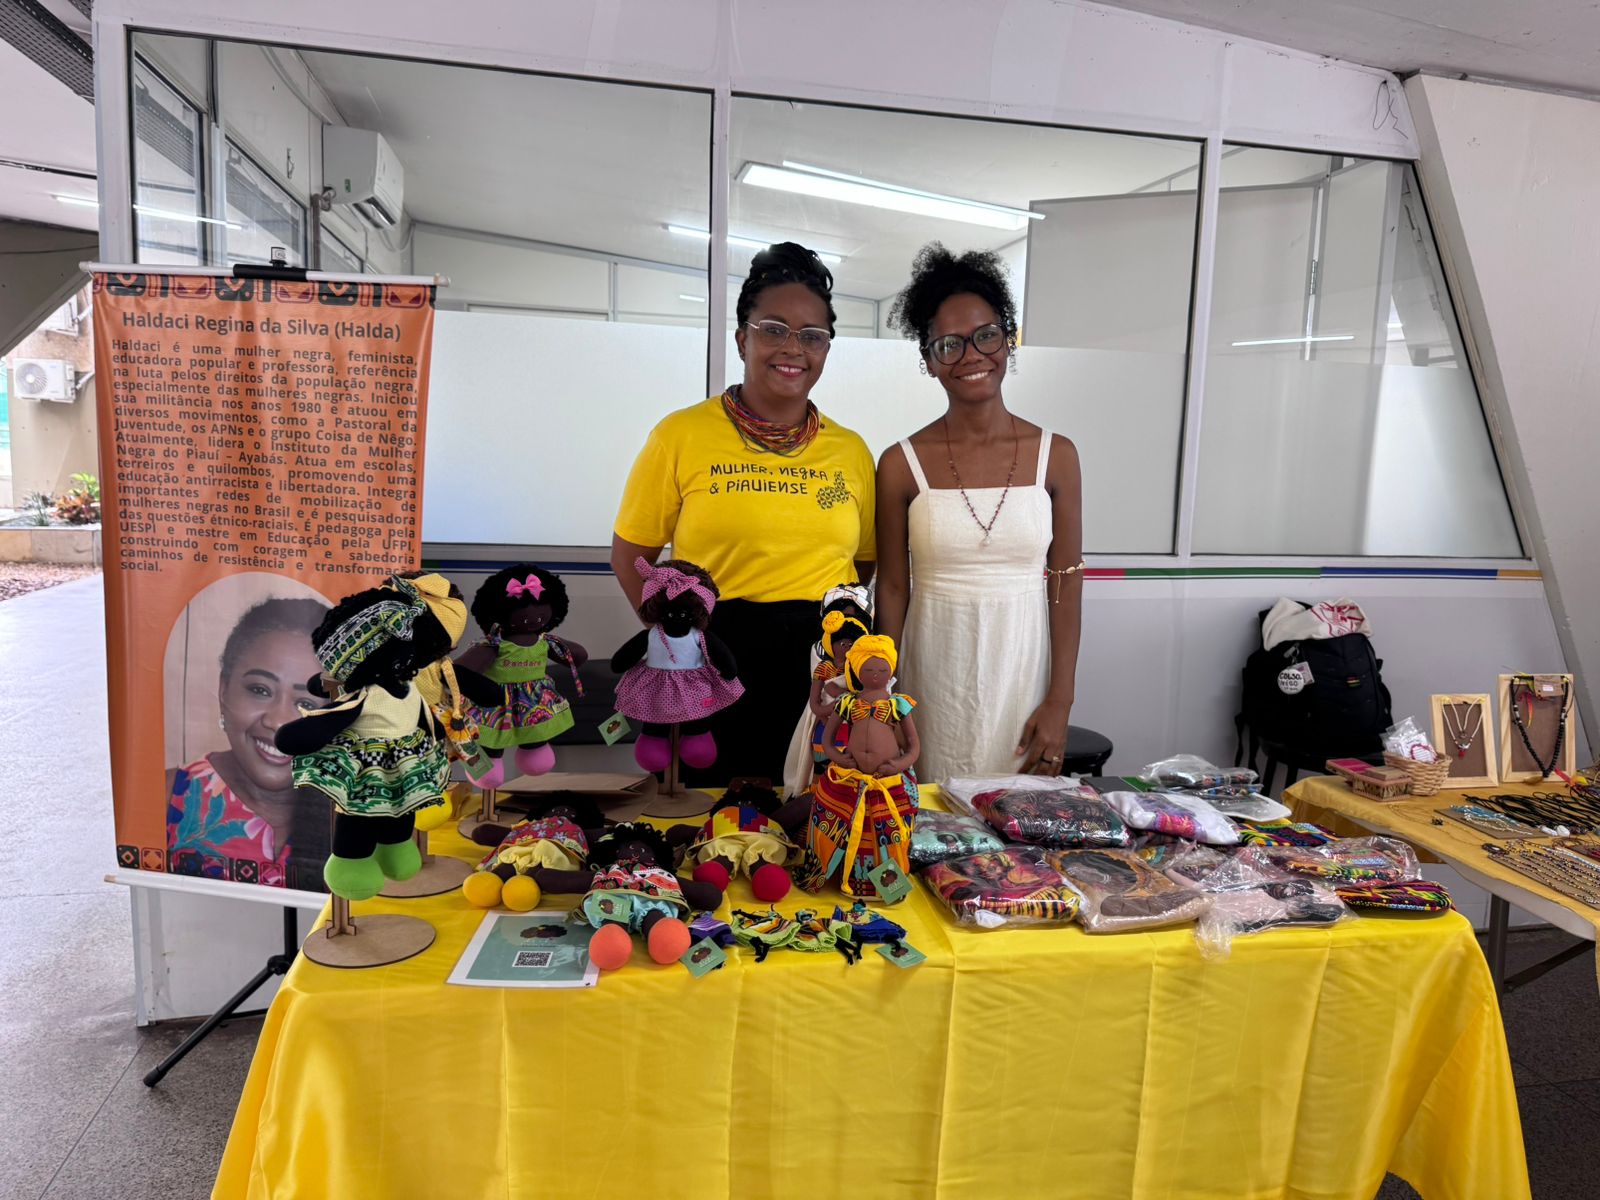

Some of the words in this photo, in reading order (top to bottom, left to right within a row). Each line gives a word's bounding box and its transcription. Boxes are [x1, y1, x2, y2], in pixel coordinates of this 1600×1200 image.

[122, 312, 189, 329] Haldaci
[195, 315, 255, 335] Regina
[260, 318, 281, 333] da
[287, 319, 329, 336] Silva
[335, 321, 400, 342] (Halda)
[112, 339, 160, 352] Haldaci
[173, 342, 180, 353] é
[192, 345, 221, 355] uma
[235, 345, 280, 357] mulher
[294, 350, 335, 363] negra,
[348, 350, 417, 366] feminista,
[113, 352, 182, 366] educadora
[190, 357, 242, 372] popular
[248, 361, 255, 370] e
[262, 360, 338, 377] professora,
[347, 364, 417, 378] referência
[113, 368, 129, 377] na
[137, 366, 162, 378] luta
[171, 369, 206, 382] pelos
[214, 370, 263, 383] direitos
[271, 373, 288, 385] da
[296, 376, 366, 391] população
[375, 381, 417, 394] negra,
[113, 380, 210, 397] especialmente
[217, 384, 240, 396] das
[245, 387, 307, 399] mulheres
[314, 392, 363, 404] negras.
[371, 392, 417, 405] Iniciou
[113, 394, 137, 403] sua
[146, 394, 212, 407] militância
[222, 400, 243, 409] nos
[251, 401, 282, 411] anos
[291, 401, 321, 413] 1980
[330, 406, 338, 414] e
[347, 406, 387, 417] atuou
[396, 410, 418, 419] em
[114, 405, 169, 418] diversos
[179, 410, 261, 425] movimentos,
[271, 416, 307, 426] como
[317, 419, 324, 427] a
[335, 417, 391, 431] Pastoral
[401, 421, 418, 432] da
[114, 418, 185, 433] Juventude,
[191, 425, 206, 433] os
[211, 423, 244, 435] APNs
[247, 428, 255, 436] e
[259, 428, 266, 437] o
[271, 429, 310, 442] grupo
[316, 429, 351, 442] Coisa
[357, 432, 373, 443] de
[379, 433, 416, 449] Nêgo.
[115, 431, 197, 447] Atualmente,
[208, 436, 244, 449] lidera
[253, 441, 261, 450] o
[271, 440, 330, 454] Instituto
[341, 444, 357, 455] da
[369, 446, 418, 459] Mulher
[116, 444, 155, 459] Negra
[163, 447, 179, 458] do
[186, 448, 219, 460] Piauí
[238, 451, 287, 465] Ayabás.
[295, 455, 327, 467] Atua
[335, 460, 355, 469] em
[363, 460, 416, 474] escolas,
[117, 458, 175, 471] terreiros
[187, 464, 195, 472] e
[207, 463, 274, 478] quilombos,
[288, 470, 374, 483] promovendo
[387, 476, 417, 486] uma
[710, 463, 773, 477] MULHER,
[117, 470, 179, 486] educação
[186, 475, 259, 489] antirracista
[265, 482, 272, 490] e
[279, 480, 360, 495] libertadora.
[368, 486, 417, 502] Integra
[118, 483, 199, 498] importantes
[216, 490, 250, 501] redes
[266, 492, 281, 504] de
[300, 496, 382, 512] mobilização
[401, 501, 416, 512] de
[709, 482, 719, 494] &
[119, 497, 180, 509] mulheres
[186, 502, 229, 515] negras
[234, 505, 249, 514] no
[254, 505, 290, 517] Brasil
[296, 510, 304, 518] e
[311, 508, 318, 519] é
[325, 511, 416, 528] pesquisadora
[119, 508, 142, 520] das
[147, 512, 205, 524] questões
[210, 515, 298, 530] étnico-raciais.
[304, 518, 311, 532] É
[317, 522, 382, 538] pedagoga
[388, 527, 415, 540] pela
[120, 521, 156, 533] UESPI
[167, 527, 175, 535] e
[186, 528, 229, 538] mestre
[239, 532, 257, 541] em
[267, 532, 329, 547] Educação
[341, 537, 369, 551] pela
[382, 539, 414, 553] UFPI,
[120, 536, 198, 549] construindo
[213, 543, 239, 552] com
[253, 546, 307, 559] coragem
[324, 551, 332, 559] e
[349, 551, 415, 564] sabedoria
[120, 548, 183, 560] caminhos
[194, 551, 208, 562] de
[218, 555, 284, 568] resistência
[296, 562, 303, 570] e
[120, 560, 162, 572] social.
